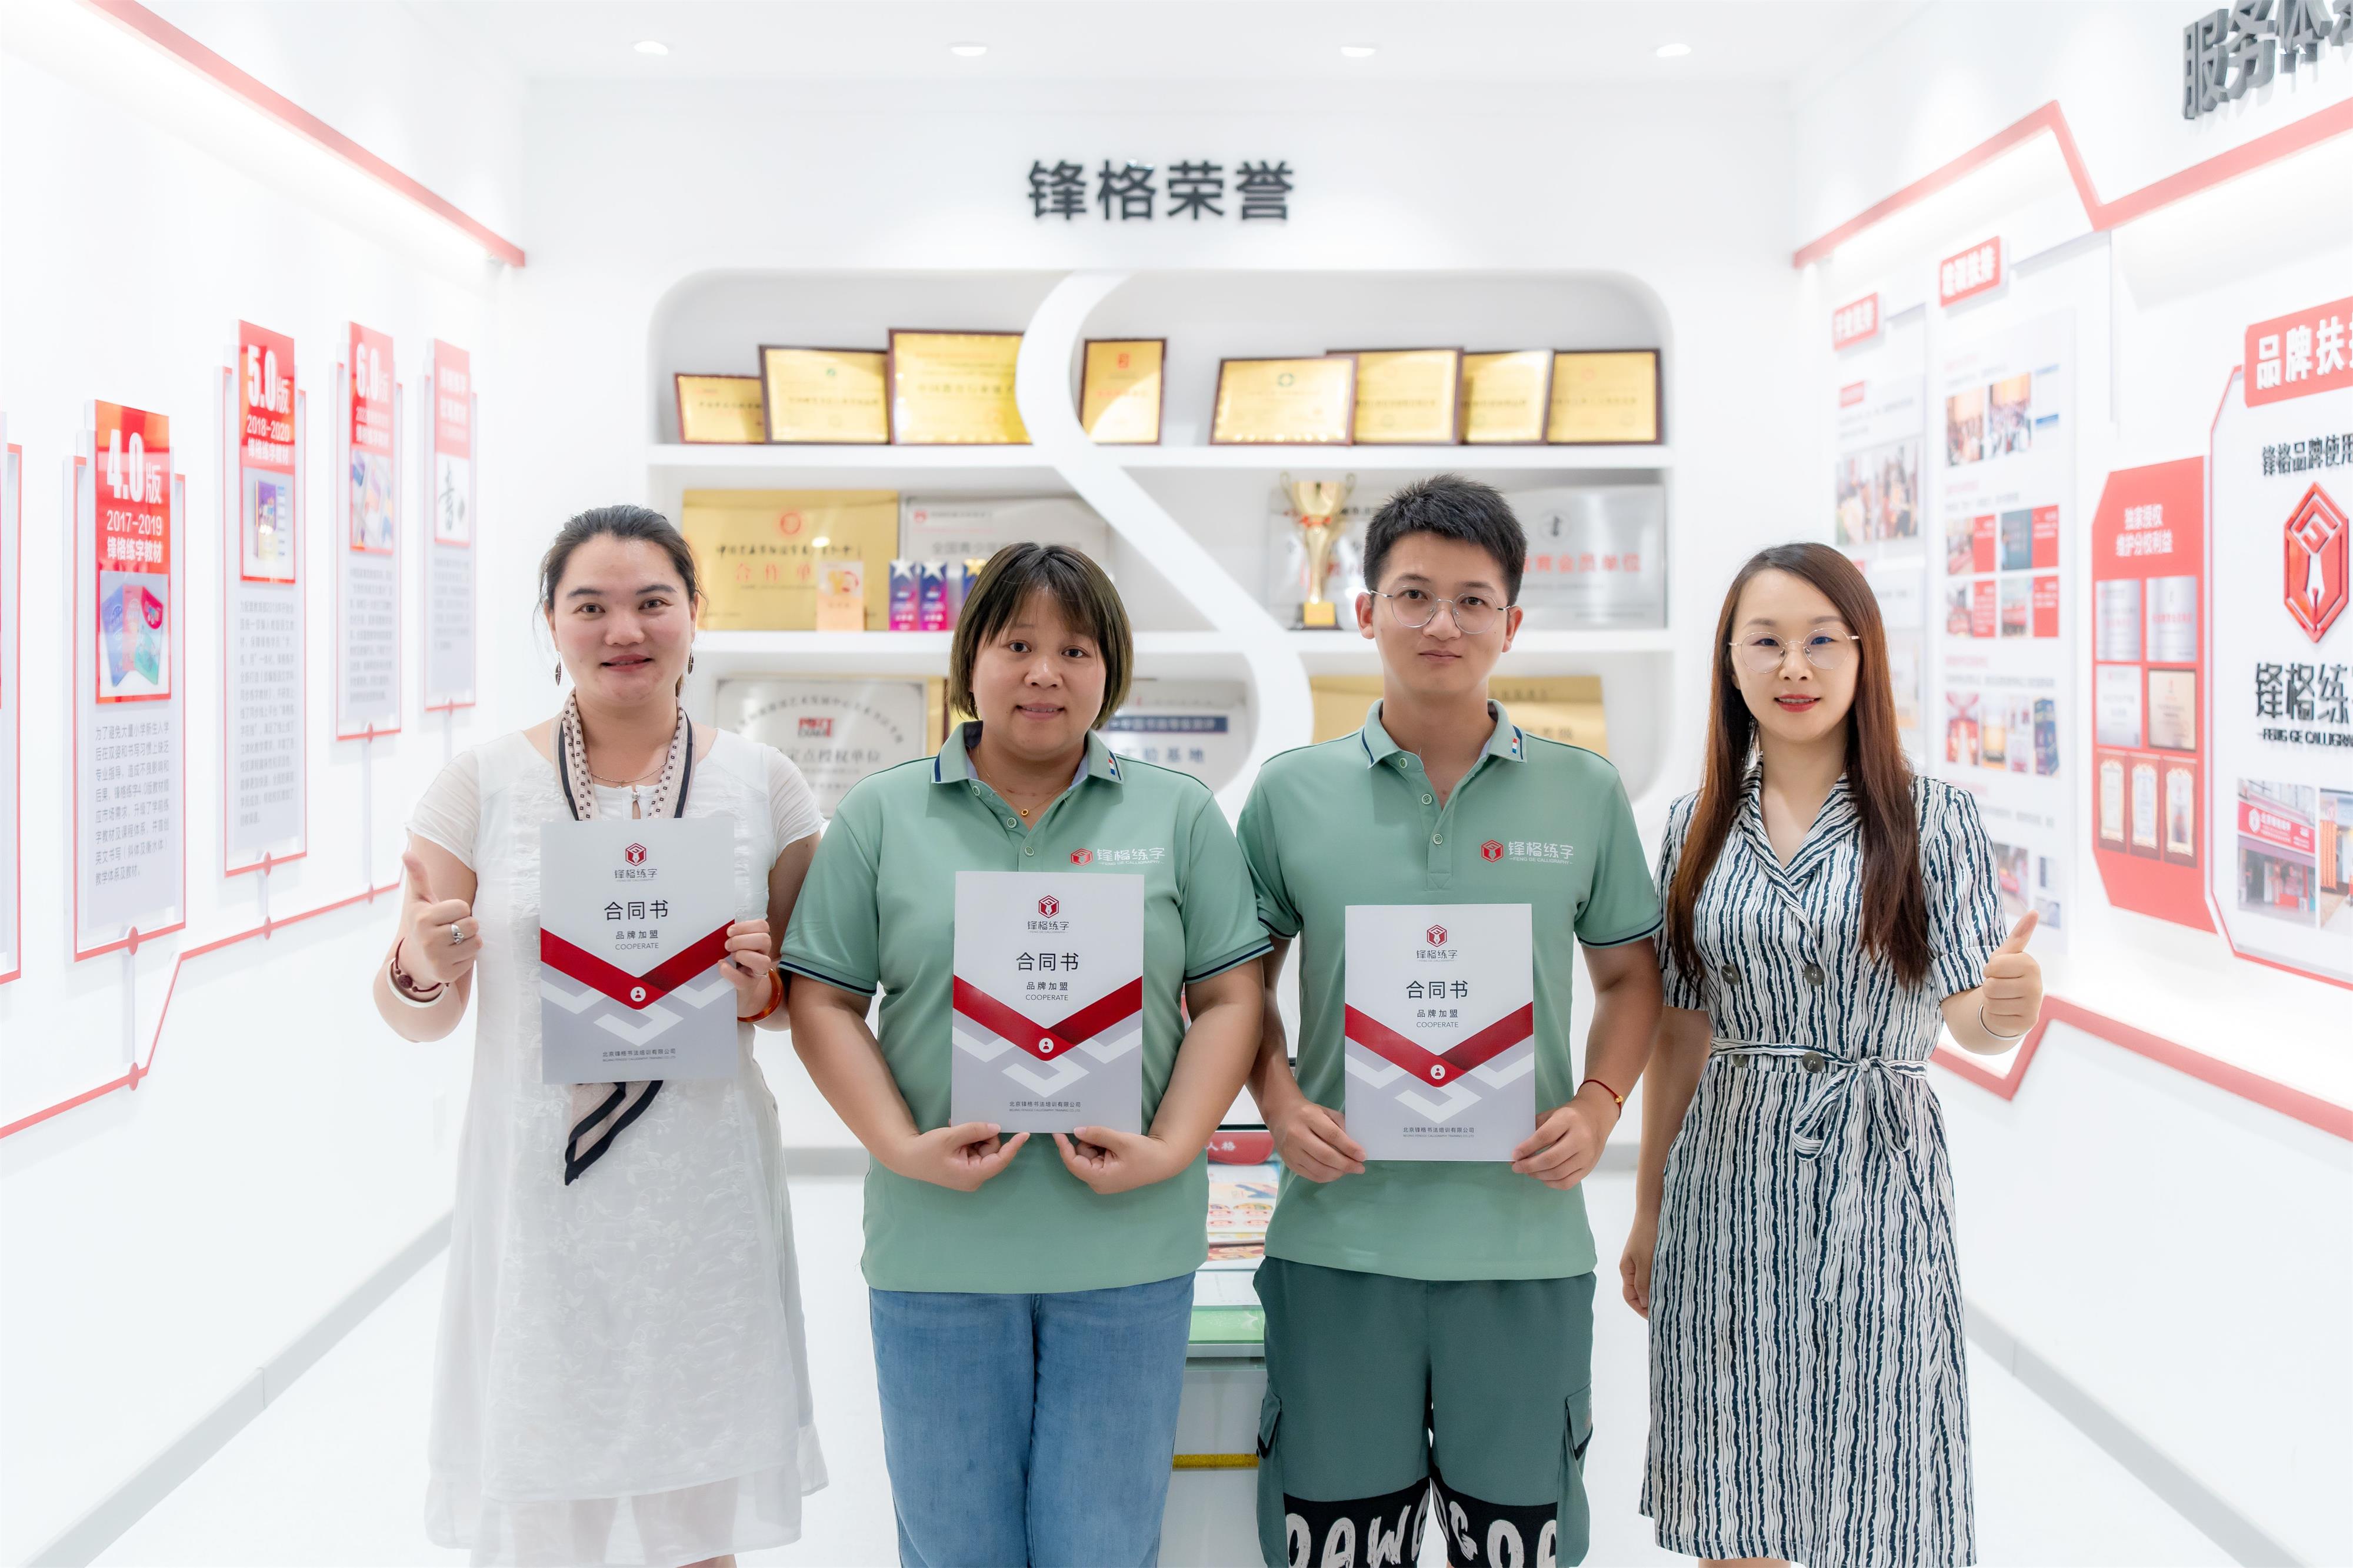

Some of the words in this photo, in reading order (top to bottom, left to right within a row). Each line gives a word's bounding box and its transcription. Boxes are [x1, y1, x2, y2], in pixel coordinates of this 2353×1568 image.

[2182, 0, 2353, 119] 服务体
[1028, 159, 1294, 220] 锋格荣誉
[2257, 316, 2353, 390] 品牌扶
[248, 343, 290, 414] 5.0版
[246, 414, 290, 442] 2018-2020
[106, 428, 162, 504] 4.0版
[106, 510, 162, 536] 2017-2019
[106, 536, 162, 563] 锋格练字教材
[1097, 847, 1165, 862] 锋格练字
[1508, 841, 1574, 859] 锋格练字
[615, 869, 658, 879] 锋格练字
[604, 899, 669, 920] 合同书
[615, 929, 659, 940] 品牌加盟
[1028, 920, 1069, 930] 锋格练字
[615, 942, 659, 950] COOPERATE
[1417, 950, 1458, 959] 锋格练字
[1015, 952, 1079, 972] 合同书
[1026, 981, 1068, 991] 品牌加盟
[1405, 980, 1469, 999] 合同书
[1417, 1009, 1459, 1018] 品牌加盟
